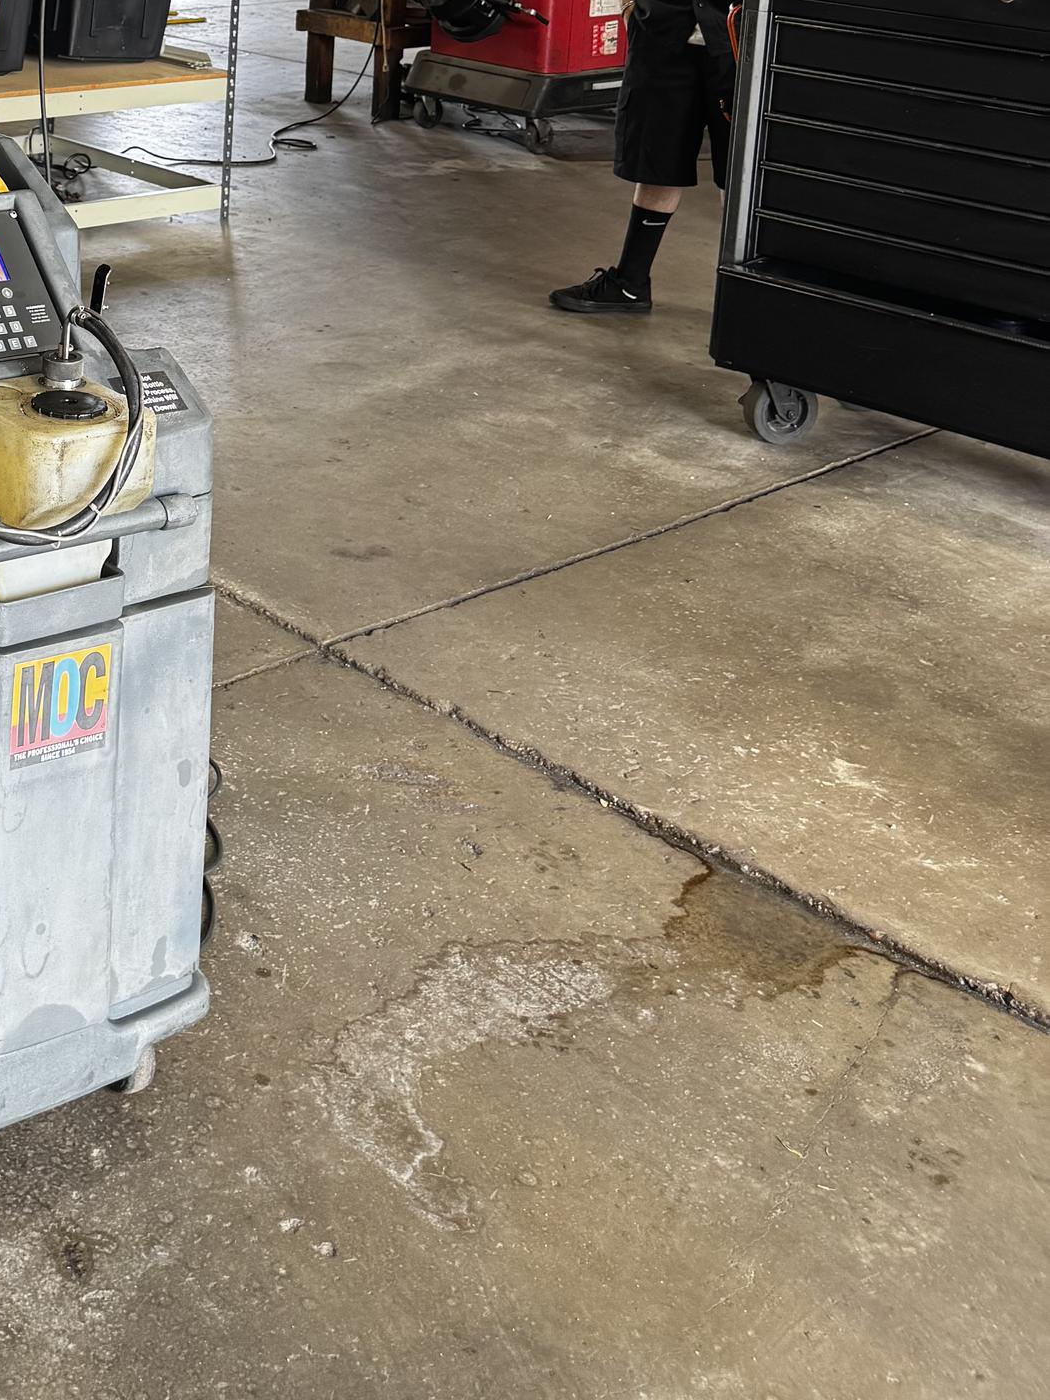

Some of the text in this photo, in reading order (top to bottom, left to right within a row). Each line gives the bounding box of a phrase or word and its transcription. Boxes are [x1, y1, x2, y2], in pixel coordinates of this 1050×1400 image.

[17, 652, 106, 748] MOC
[14, 752, 26, 762] THE
[80, 732, 104, 745] CHOICE
[41, 747, 76, 762] SINCE 1954
